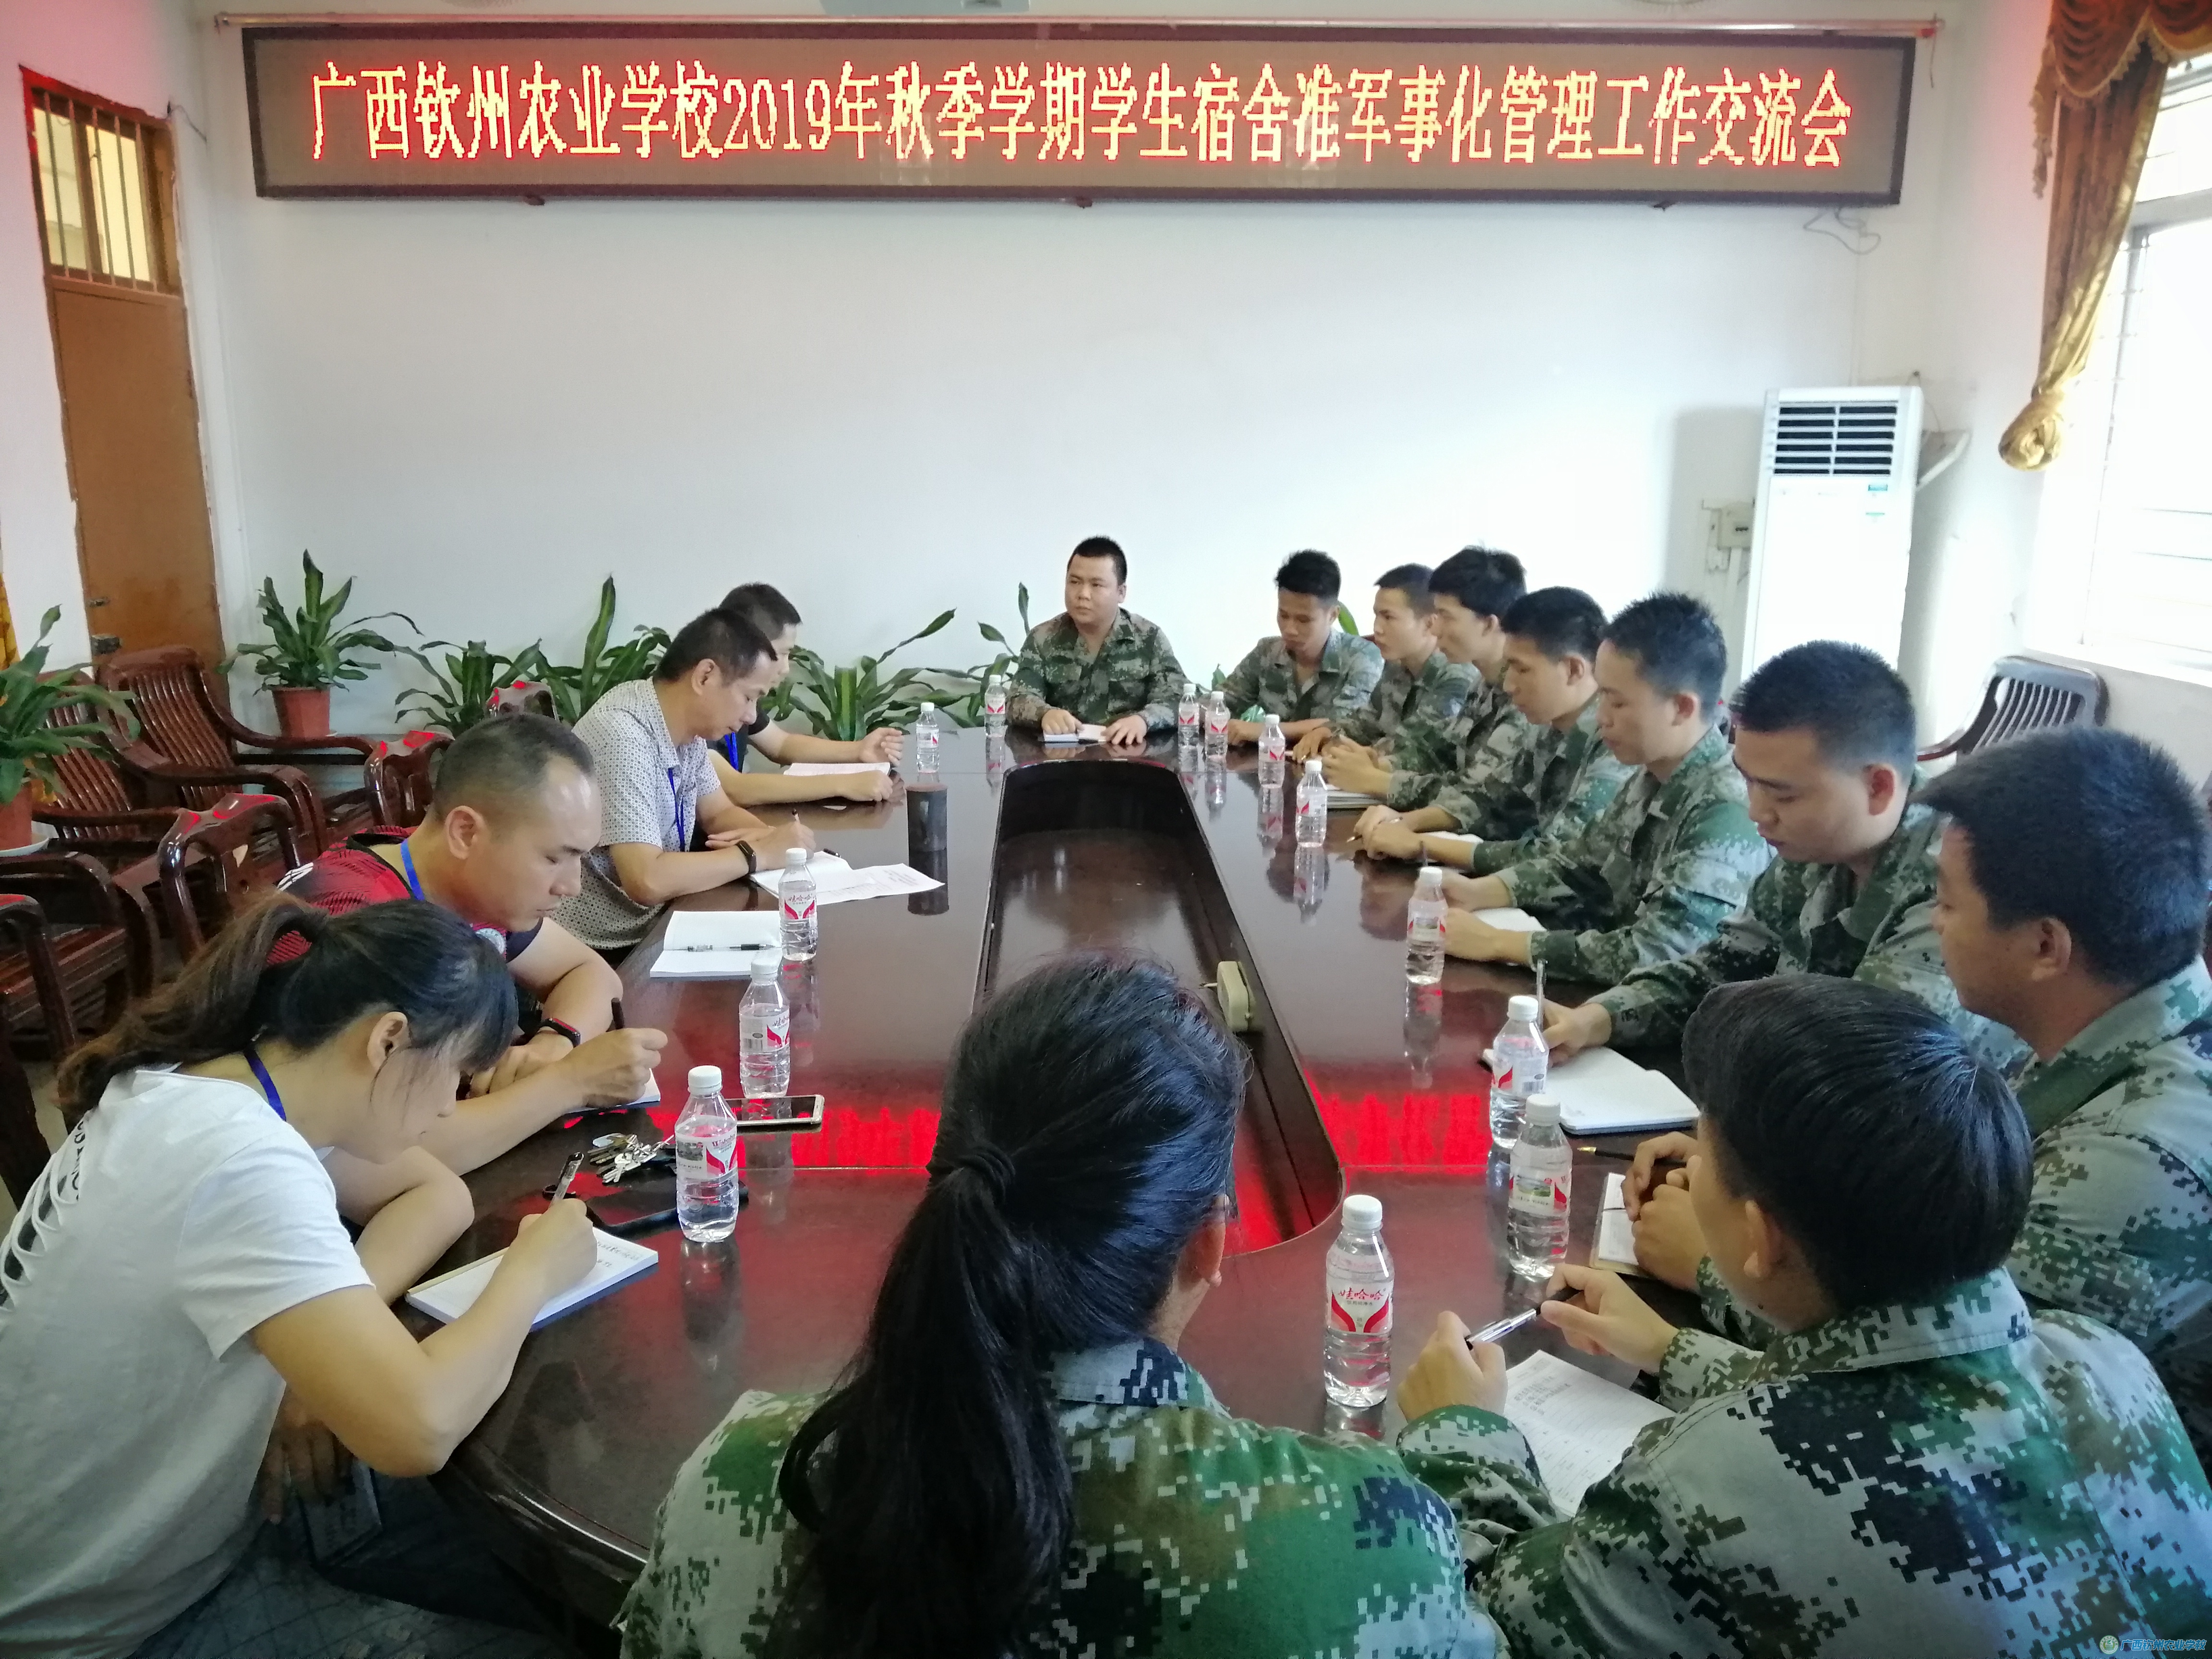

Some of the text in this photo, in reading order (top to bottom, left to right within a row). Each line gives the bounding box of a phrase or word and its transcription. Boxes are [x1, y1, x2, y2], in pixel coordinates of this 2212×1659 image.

[312, 60, 1851, 167] 广西钦州农业学校2019年秋季学期学生宿舍准军事化管理工作交流会
[1338, 1287, 1383, 1300] 娃哈哈
